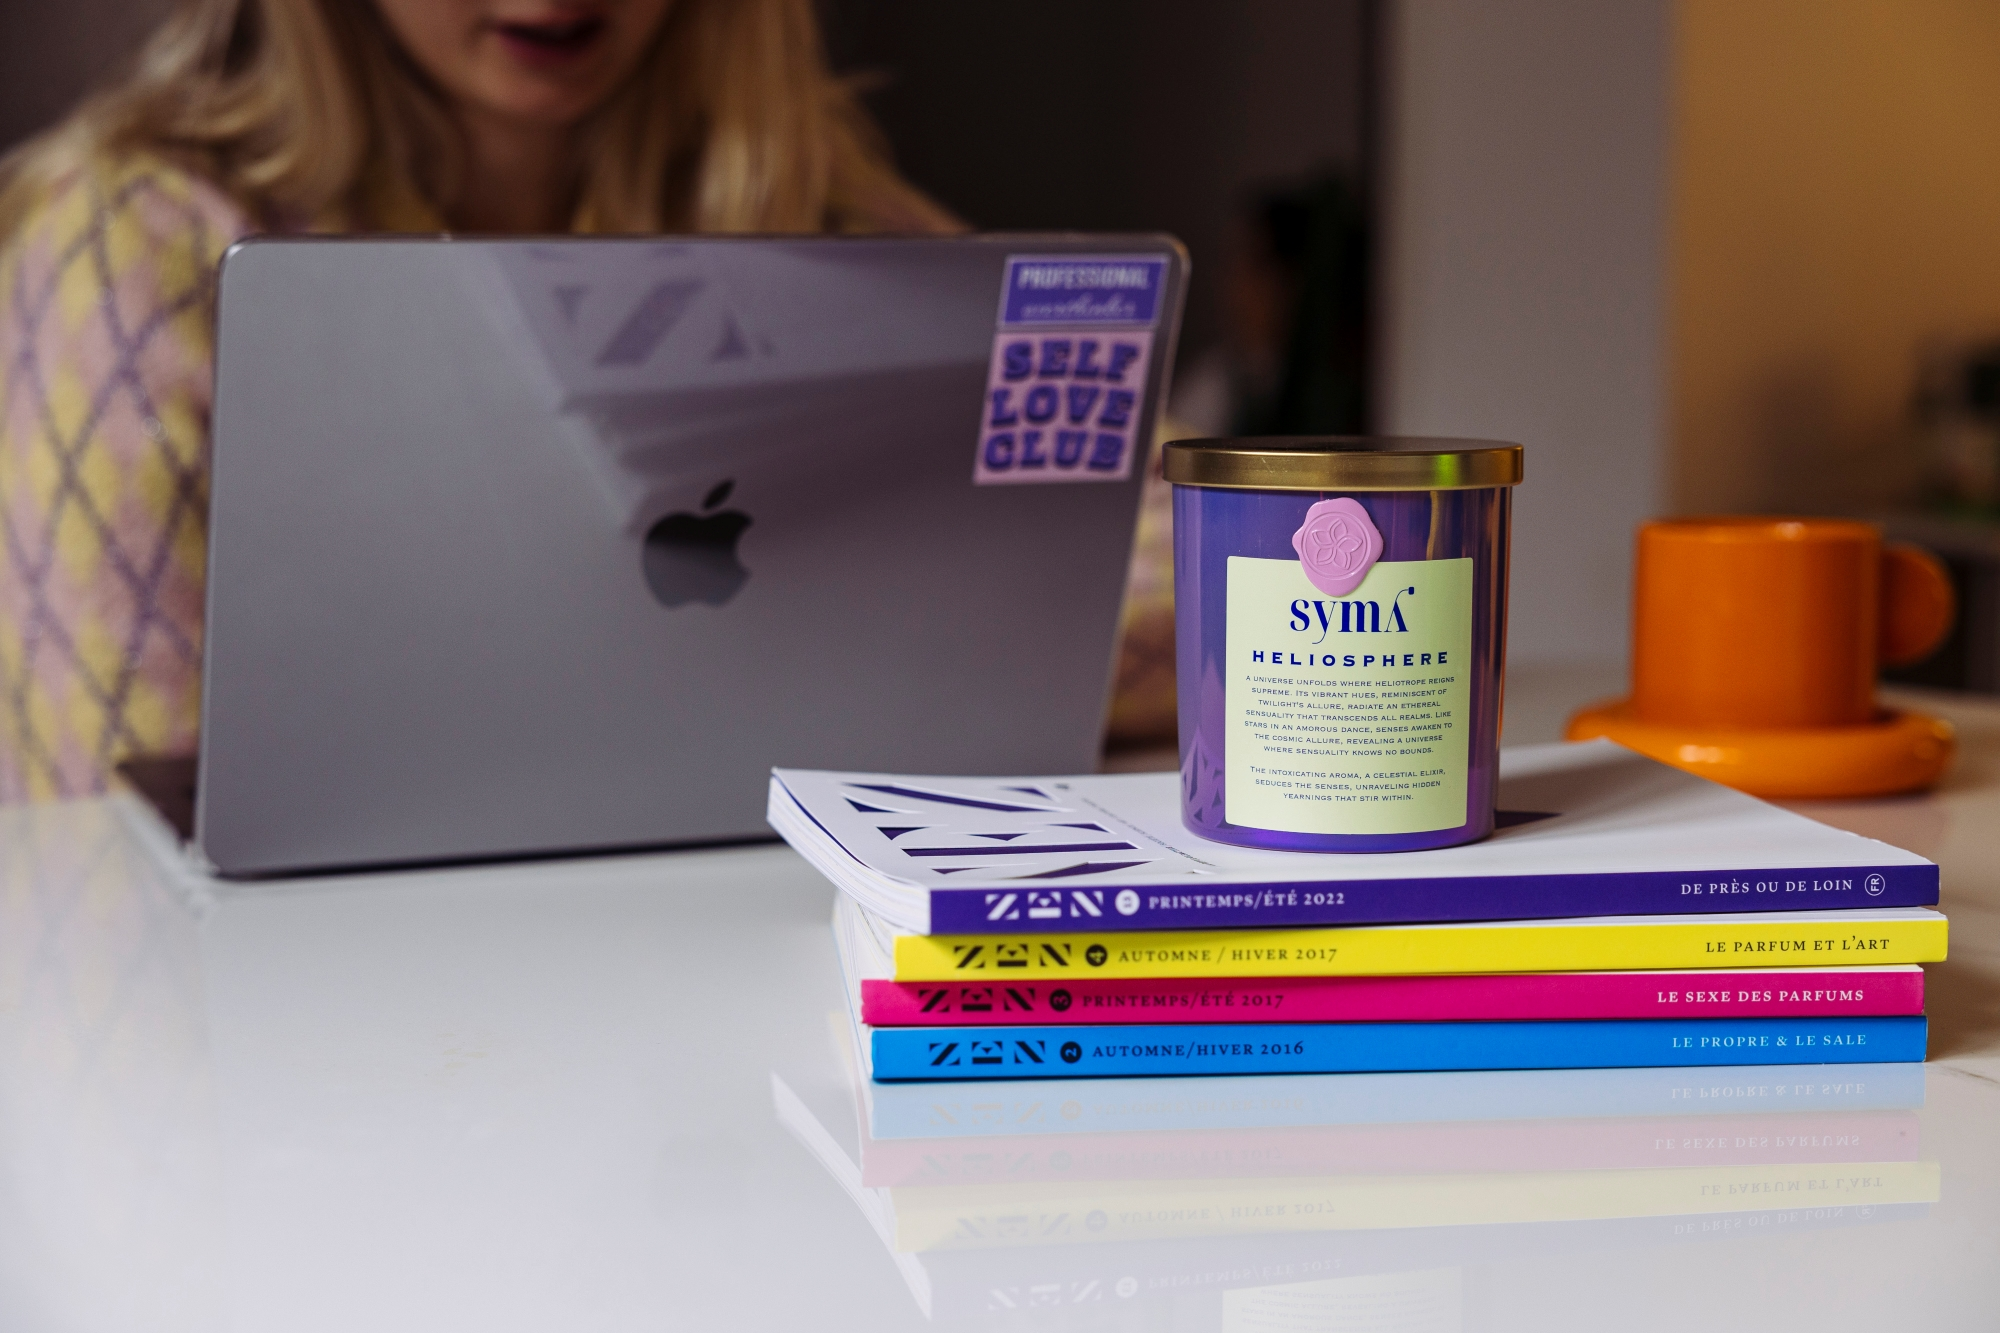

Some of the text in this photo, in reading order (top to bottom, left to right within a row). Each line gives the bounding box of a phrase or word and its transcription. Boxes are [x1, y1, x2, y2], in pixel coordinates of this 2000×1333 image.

[1004, 340, 1140, 382] SELF
[991, 384, 1135, 427] LOVE
[985, 429, 1124, 471] CLUB
[1252, 650, 1448, 667] HELIOSPHERE
[1254, 676, 1293, 684] UNIVERSE
[1252, 687, 1292, 696] SUPREME.
[1382, 690, 1436, 698] REMINISCENT
[1258, 699, 1304, 708] TWILIGHT'S
[1401, 701, 1441, 709] ETHEREAL
[1246, 710, 1294, 719] SENSUALITY
[1321, 714, 1378, 722] TRANSCENDS
[1411, 723, 1441, 731] AWAKEN
[1272, 735, 1303, 743] COSMIC
[1406, 735, 1443, 743] UNIVERSE
[1296, 748, 1349, 756] SENSUALITY
[1269, 769, 1326, 778] INTOXICATING
[1255, 779, 1292, 787] SEDUCES
[1315, 783, 1352, 791] SENSES,
[1283, 793, 1332, 801] YEARNINGS
[1681, 882, 1702, 895] DE
[1709, 878, 1750, 894] PRÈS
[1756, 881, 1779, 893] OU
[1786, 880, 1808, 892] DE
[1813, 879, 1853, 891] LOIN
[1148, 889, 1298, 910] PRINTEMPS/ÉTÉ
[1304, 892, 1345, 906] 2022
[1706, 941, 1726, 952] LE
[1733, 940, 1807, 952] PARFUM
[1814, 939, 1835, 951] ET
[1118, 950, 1211, 962] AUTOMNE
[1232, 949, 1288, 960] HIVER
[1296, 948, 1338, 962] 2017
[1083, 990, 1235, 1010] PRINTEMPS/ÉTÉ
[1242, 995, 1284, 1009] 2017
[1658, 989, 1864, 1002] LE SEXE DES PARFUMS
[1672, 1034, 1867, 1048] LE PROPRE & LE SALE
[1092, 1041, 1254, 1060] AUTOMNE/HIVER
[1261, 1041, 1304, 1055] 2016
